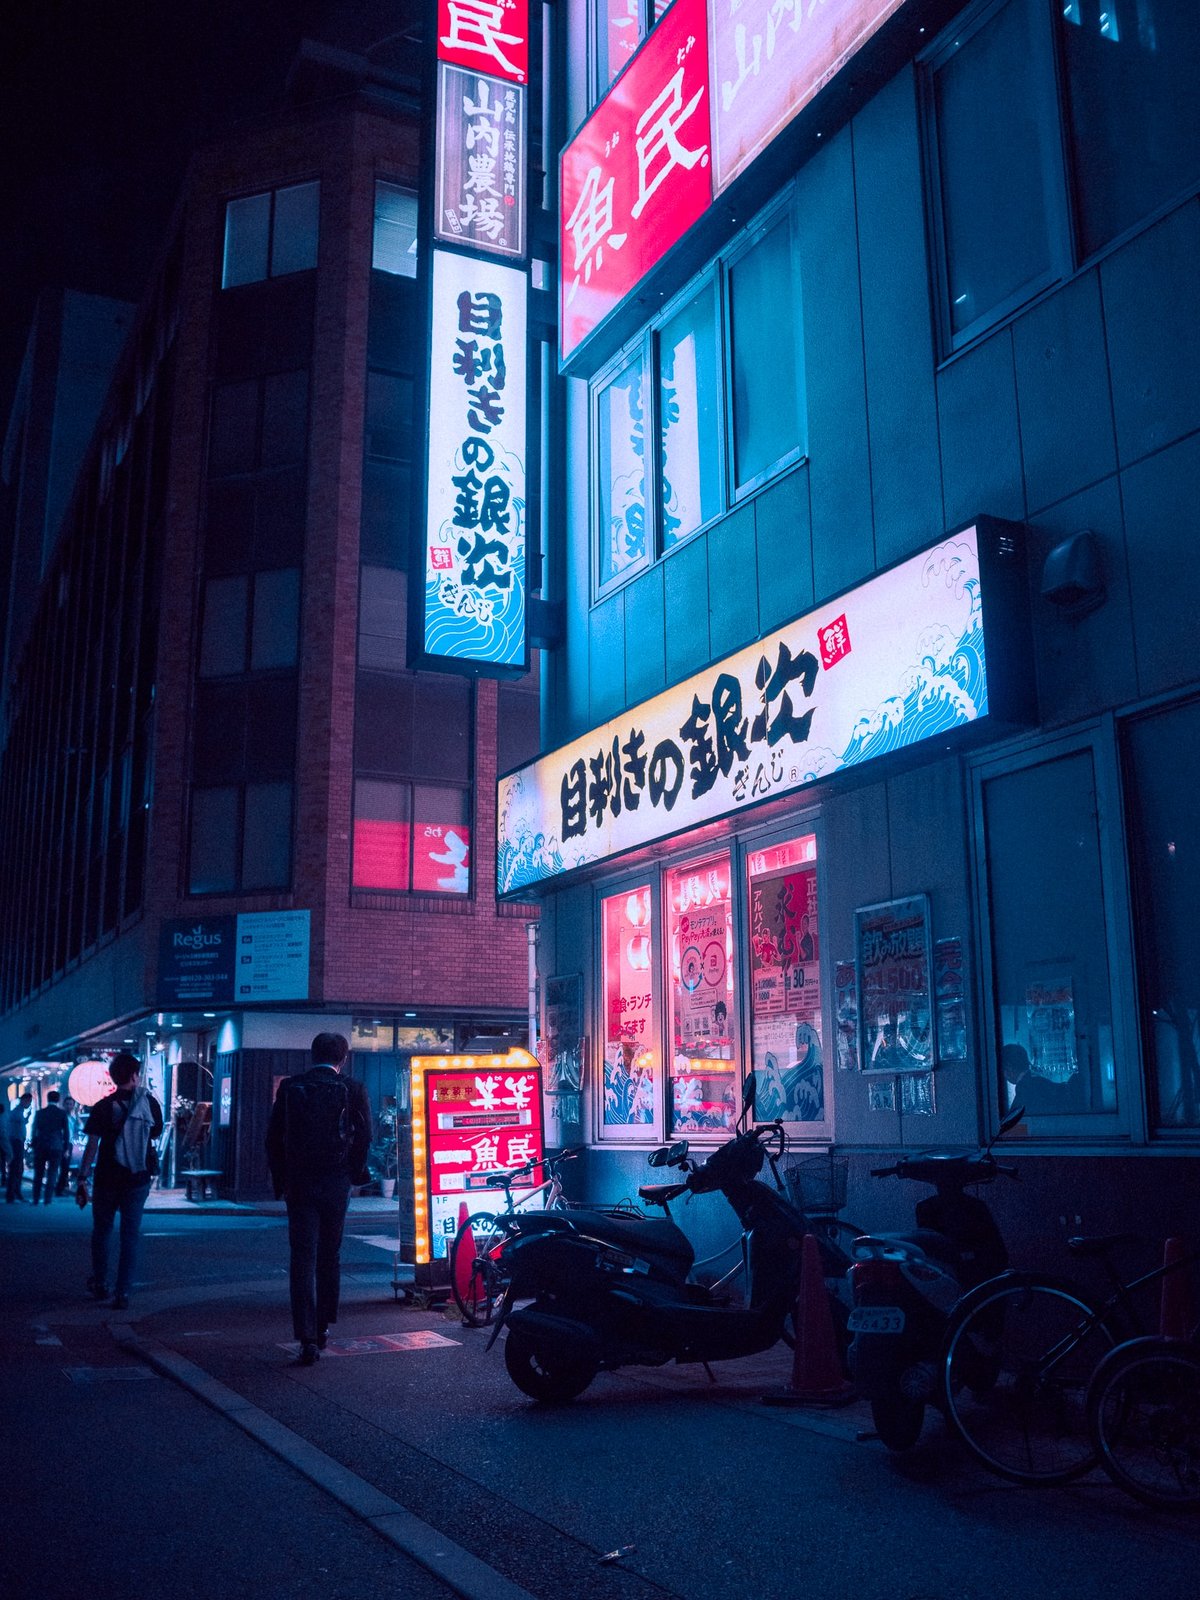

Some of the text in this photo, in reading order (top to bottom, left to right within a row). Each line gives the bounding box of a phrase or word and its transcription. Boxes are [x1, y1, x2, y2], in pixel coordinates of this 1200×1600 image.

[459, 79, 505, 240] 山内農場
[564, 67, 708, 307] 魚民
[452, 291, 514, 592] 目利きの銀次
[441, 583, 491, 623] ぎんじ
[561, 641, 819, 844] 目利きの銀次
[732, 748, 785, 802] ぎんじ
[173, 931, 222, 950] Regus
[471, 1137, 537, 1171] 魚民
